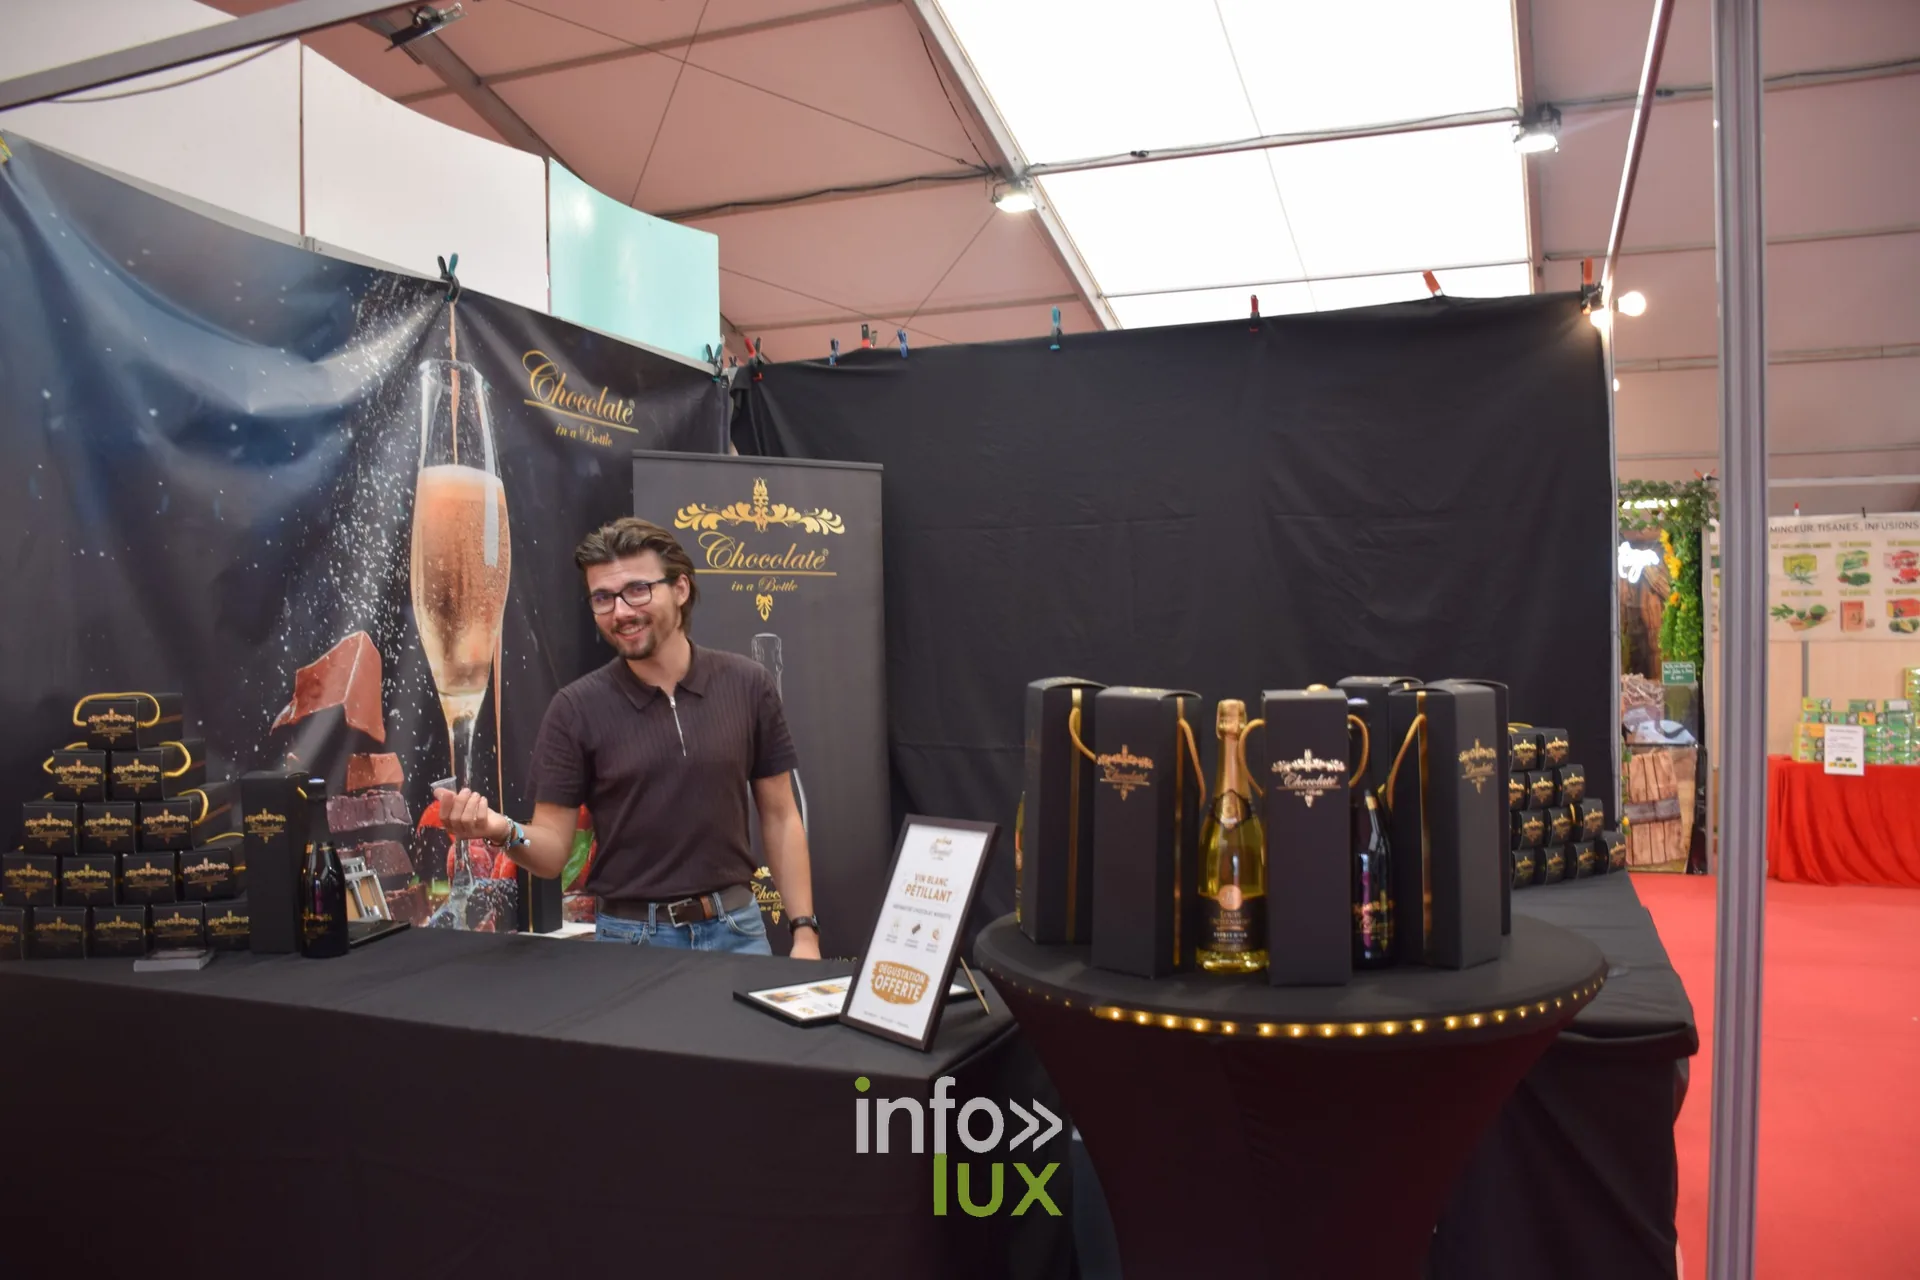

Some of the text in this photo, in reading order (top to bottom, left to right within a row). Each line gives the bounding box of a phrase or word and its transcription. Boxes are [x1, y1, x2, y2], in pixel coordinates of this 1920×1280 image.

[579, 424, 613, 448] Bottle
[731, 576, 798, 593] in a Bottle
[904, 882, 953, 904] PÉTILLANT
[874, 974, 922, 1001] OFFERTE
